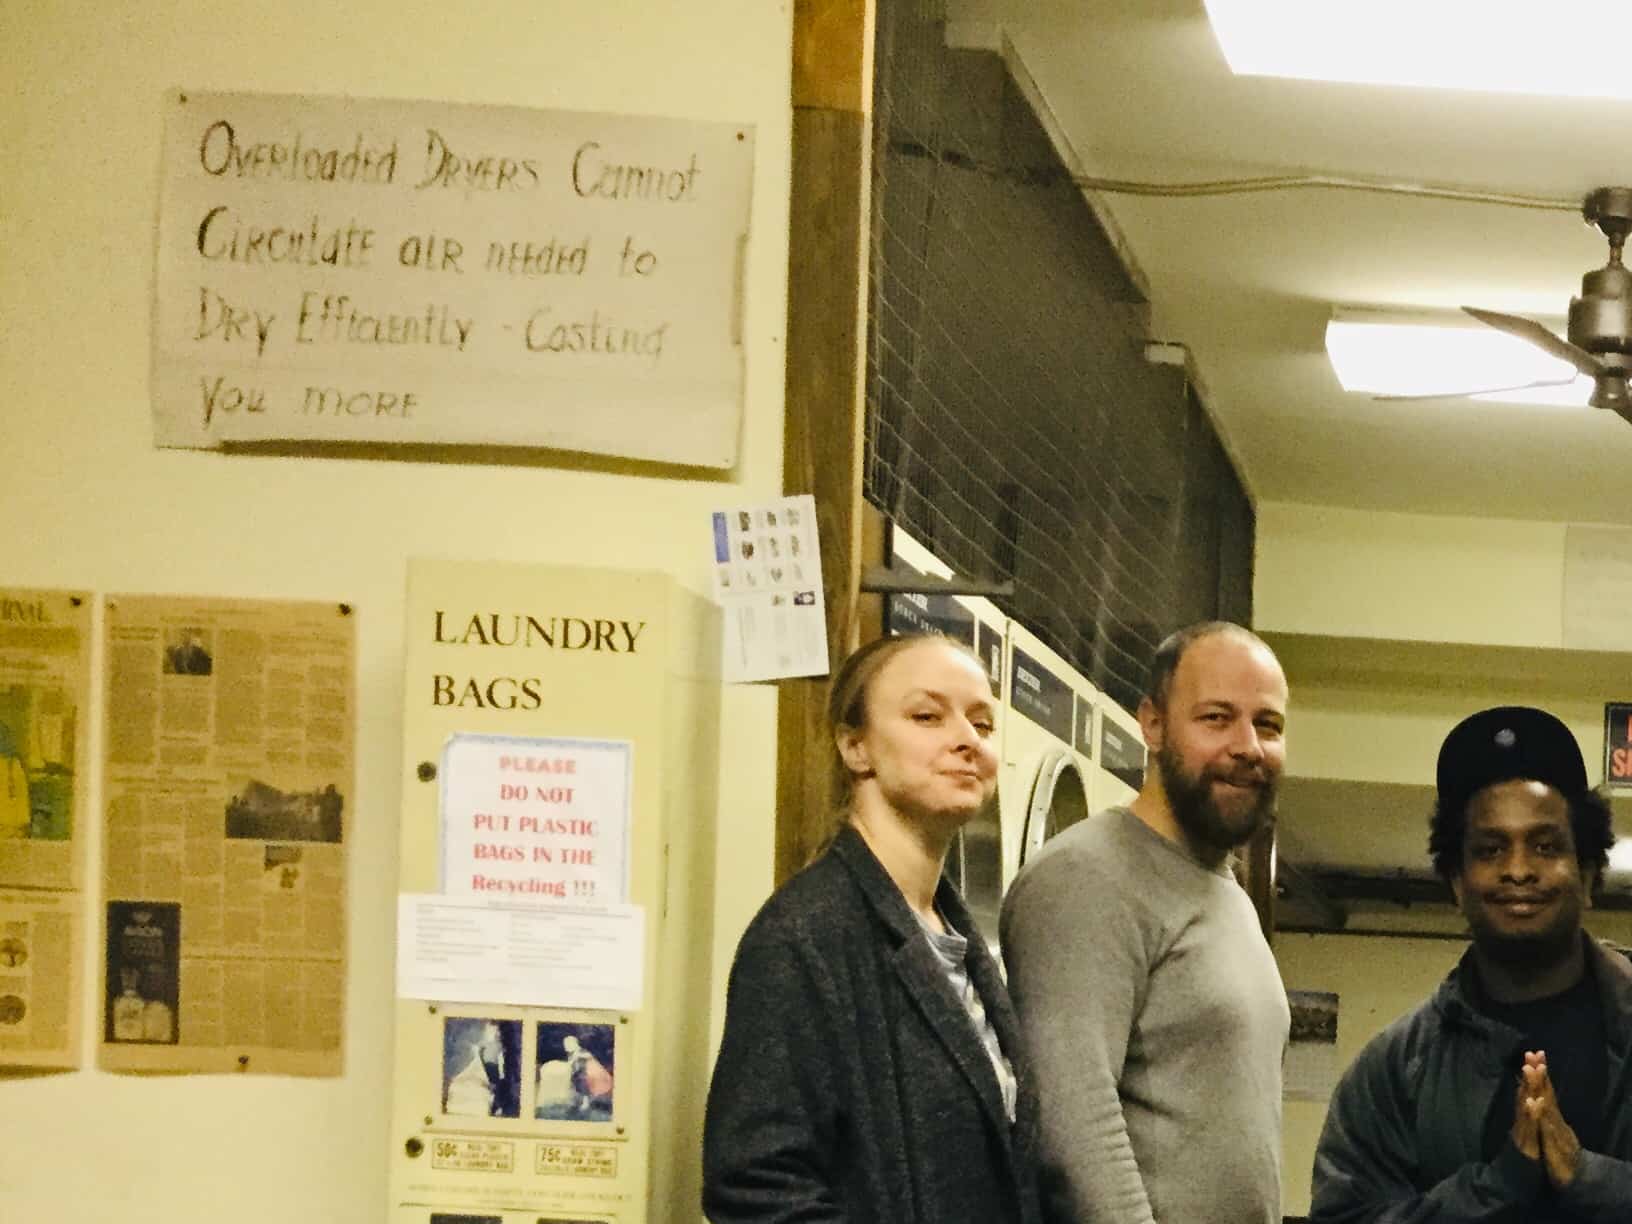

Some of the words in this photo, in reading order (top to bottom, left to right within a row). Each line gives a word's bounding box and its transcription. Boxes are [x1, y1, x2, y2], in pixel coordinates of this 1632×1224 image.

[622, 236, 658, 277] to
[433, 610, 647, 654] LAUNDRY
[433, 674, 543, 710] BAGS
[499, 755, 577, 775] PLEASE
[500, 783, 529, 802] DO
[536, 786, 576, 804] NOT
[474, 813, 512, 832] PUT
[519, 815, 598, 836] PLASTIC
[473, 843, 526, 862] BAGS
[533, 846, 553, 864] IN
[560, 848, 596, 867] THE
[472, 874, 567, 898] Recycling
